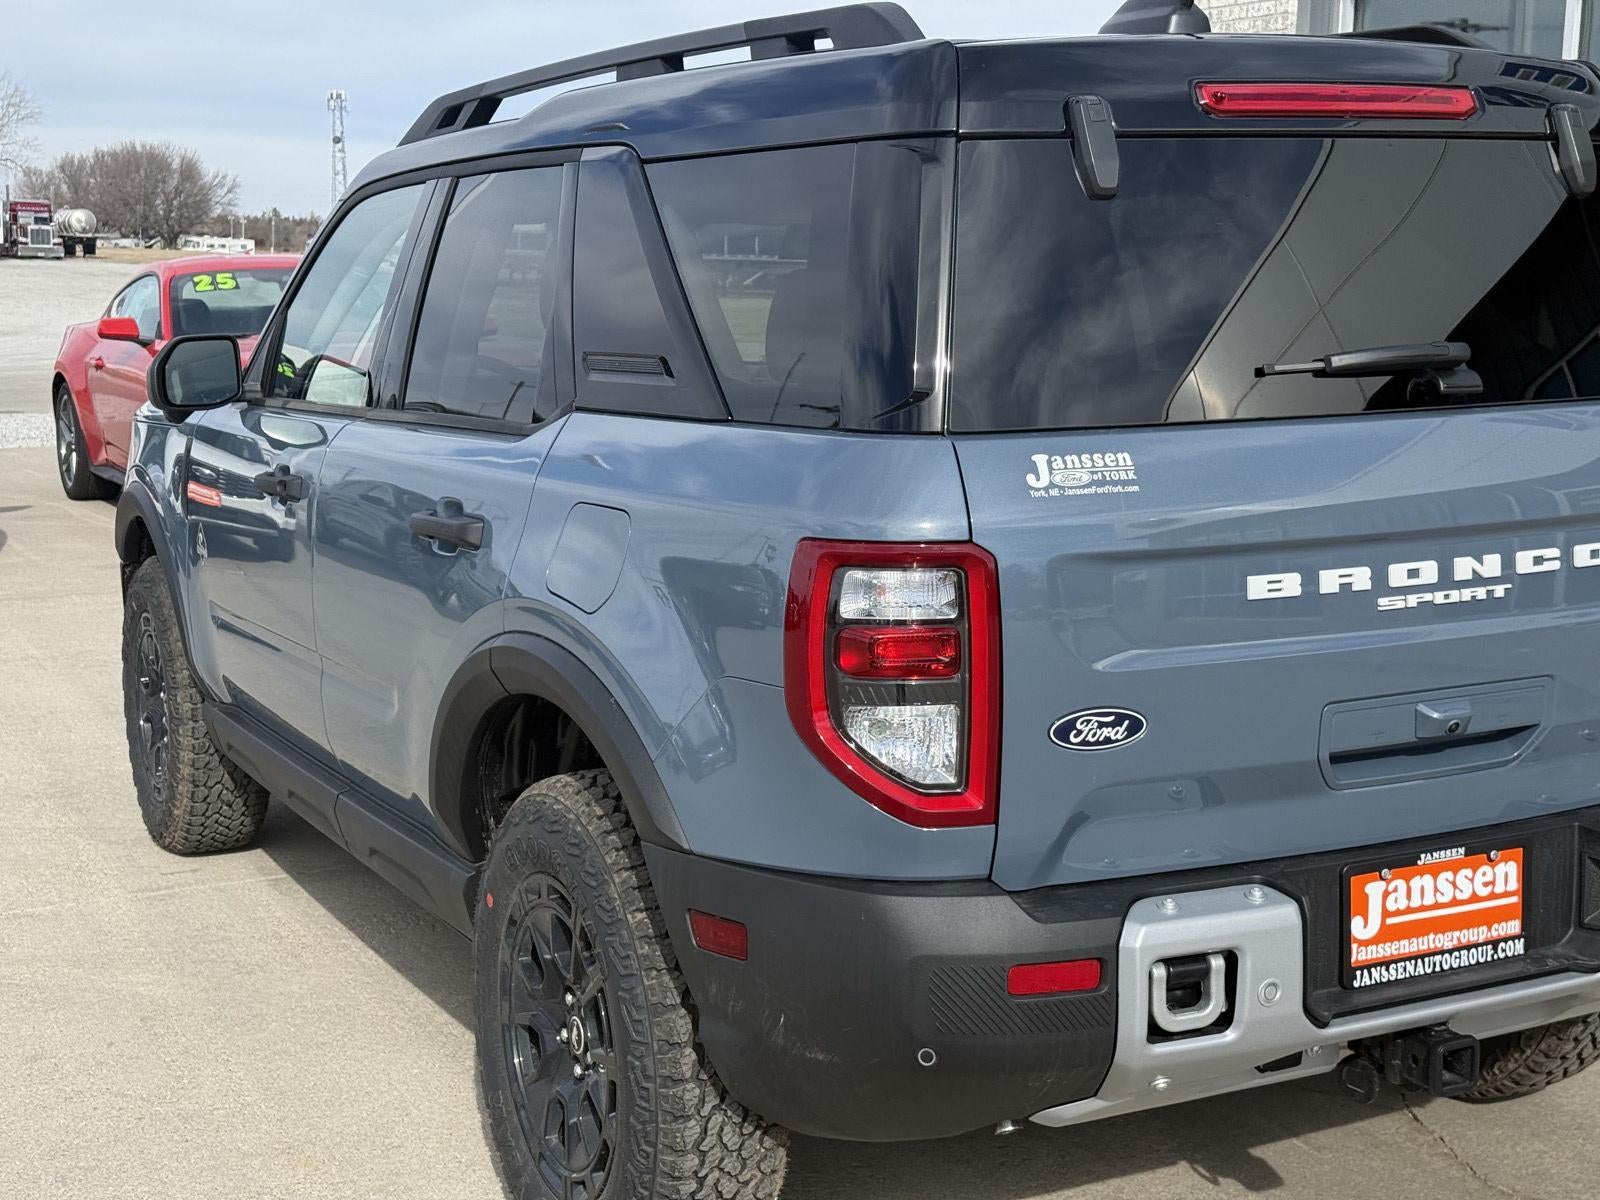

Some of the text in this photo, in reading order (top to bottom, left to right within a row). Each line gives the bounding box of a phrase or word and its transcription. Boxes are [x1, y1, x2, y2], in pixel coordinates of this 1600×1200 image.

[193, 272, 237, 291] 25
[1026, 452, 1133, 488] Janssen
[1103, 471, 1137, 480] YORK
[1029, 489, 1048, 497] York,
[1247, 542, 1600, 601] BRONCO
[1377, 583, 1512, 611] SPORT
[1069, 715, 1130, 744] Ford
[1417, 847, 1465, 865] JANSSEN
[1351, 860, 1518, 940] Janssen
[1351, 918, 1520, 963] Janssenautogroup.com
[1353, 938, 1525, 988] JANSSENAUTOGROUP.COM
